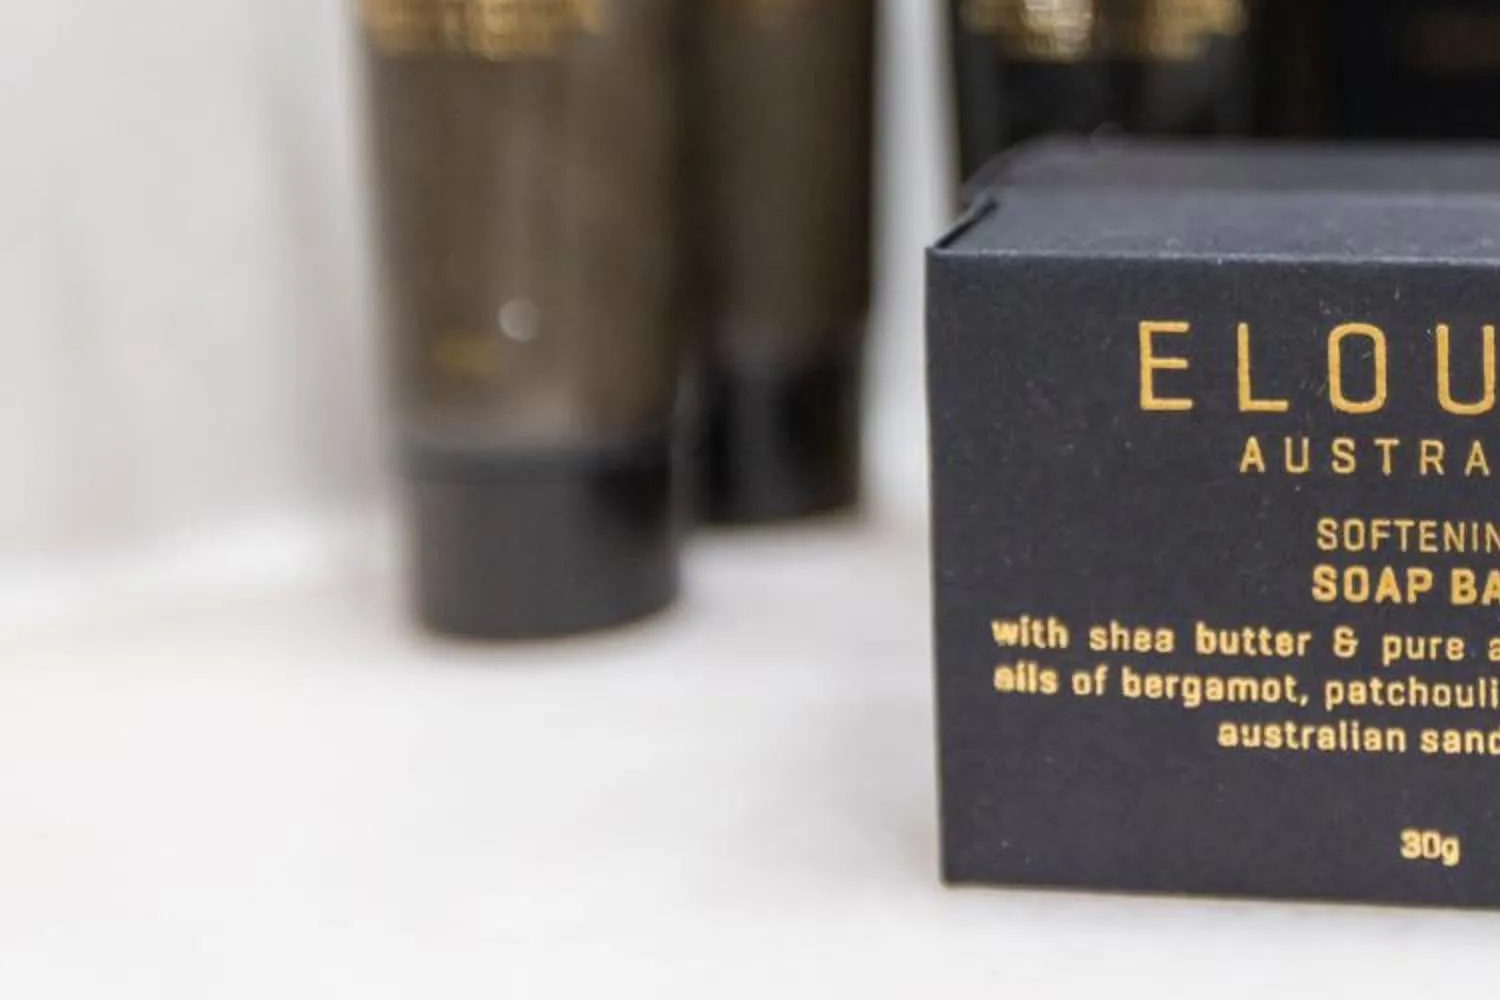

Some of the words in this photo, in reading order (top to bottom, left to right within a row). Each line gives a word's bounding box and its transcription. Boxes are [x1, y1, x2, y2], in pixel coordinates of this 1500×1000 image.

[1311, 561, 1435, 605] SOAP
[991, 616, 1071, 648] with
[1087, 622, 1177, 653] shea
[1192, 622, 1312, 657] butter
[1331, 624, 1358, 658] &
[1380, 633, 1465, 665] pure
[1070, 663, 1107, 696] of
[1121, 665, 1306, 709] bergamot,
[1217, 720, 1406, 752] australian
[1401, 827, 1461, 866] 30g
